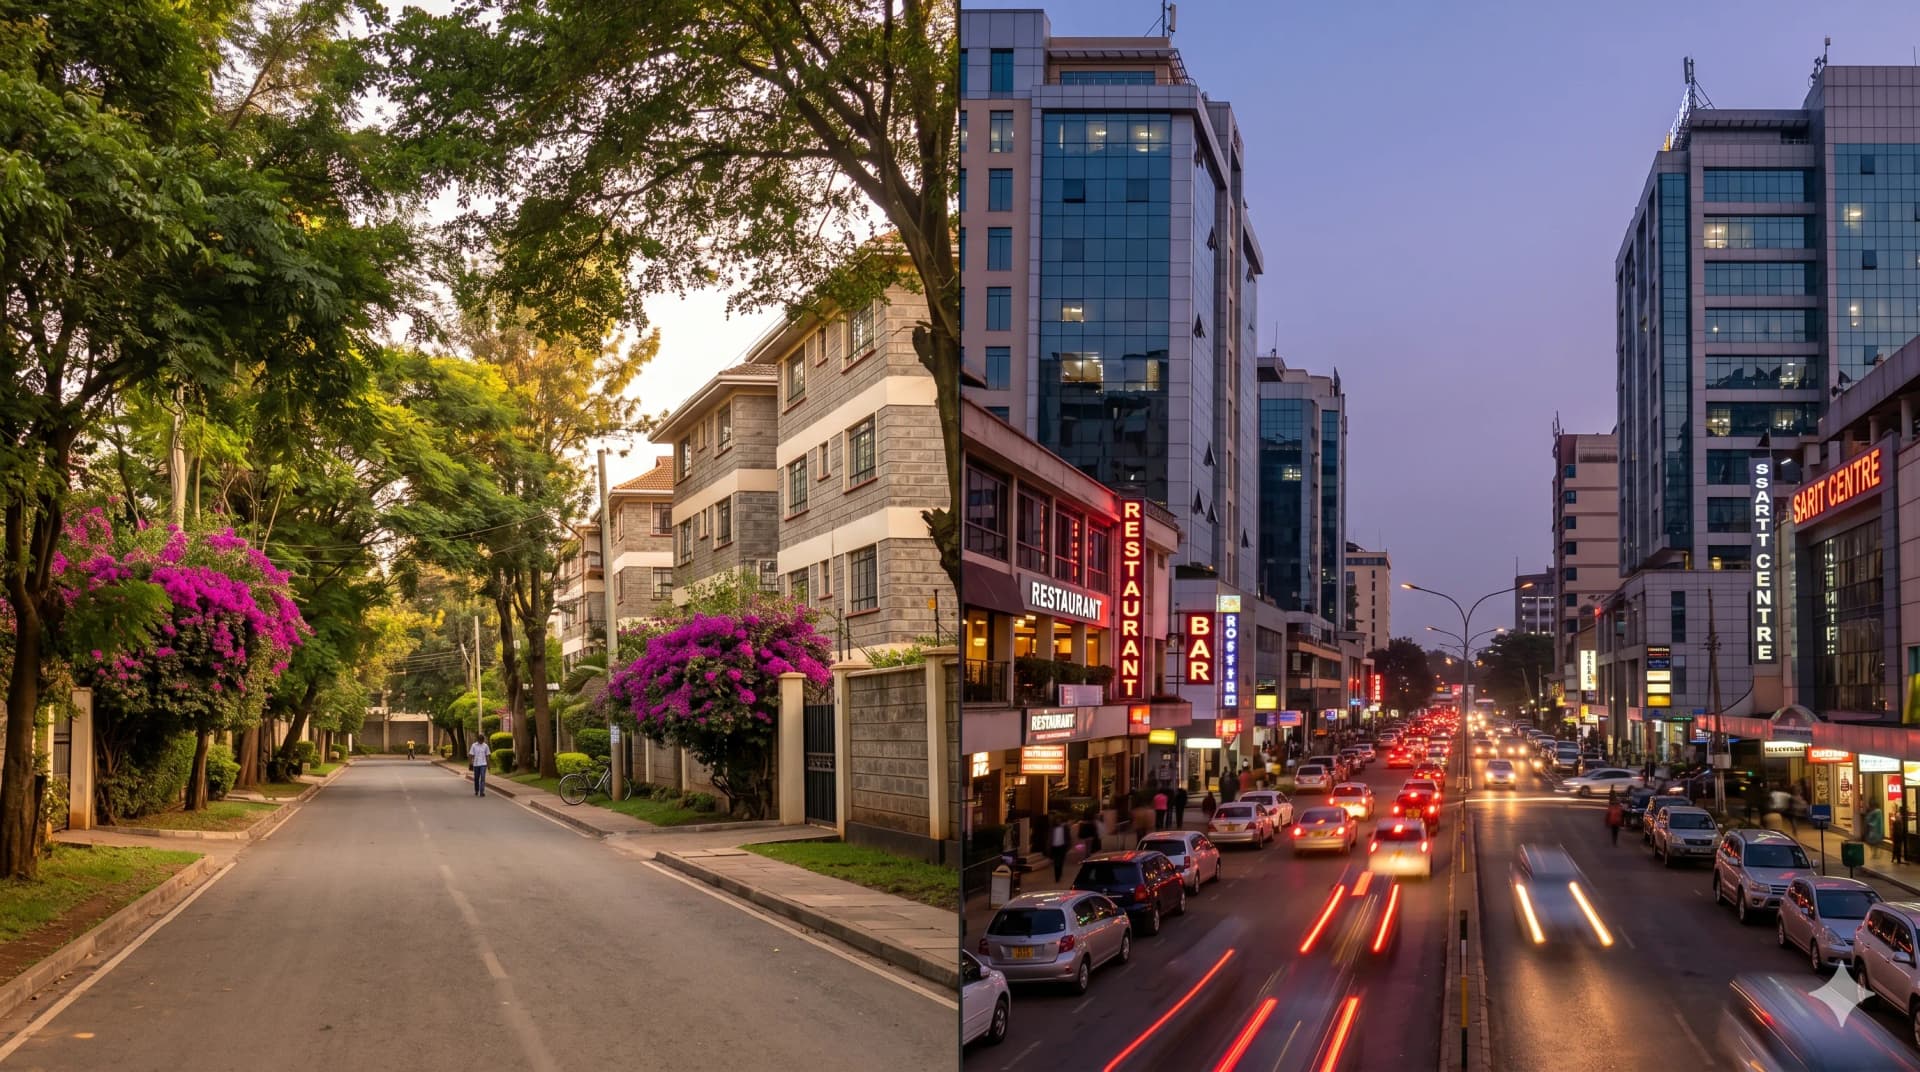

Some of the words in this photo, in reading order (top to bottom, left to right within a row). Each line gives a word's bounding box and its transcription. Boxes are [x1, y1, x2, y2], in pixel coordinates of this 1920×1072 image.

[1755, 464, 1770, 547] SSARTT
[1794, 480, 1825, 524] SARIT
[1828, 448, 1880, 507] CENTRE
[1031, 582, 1102, 620] RESTAURANT
[1122, 502, 1140, 696] RESTAURANT
[1756, 554, 1772, 660] CENTRE
[1189, 616, 1210, 681] BAR
